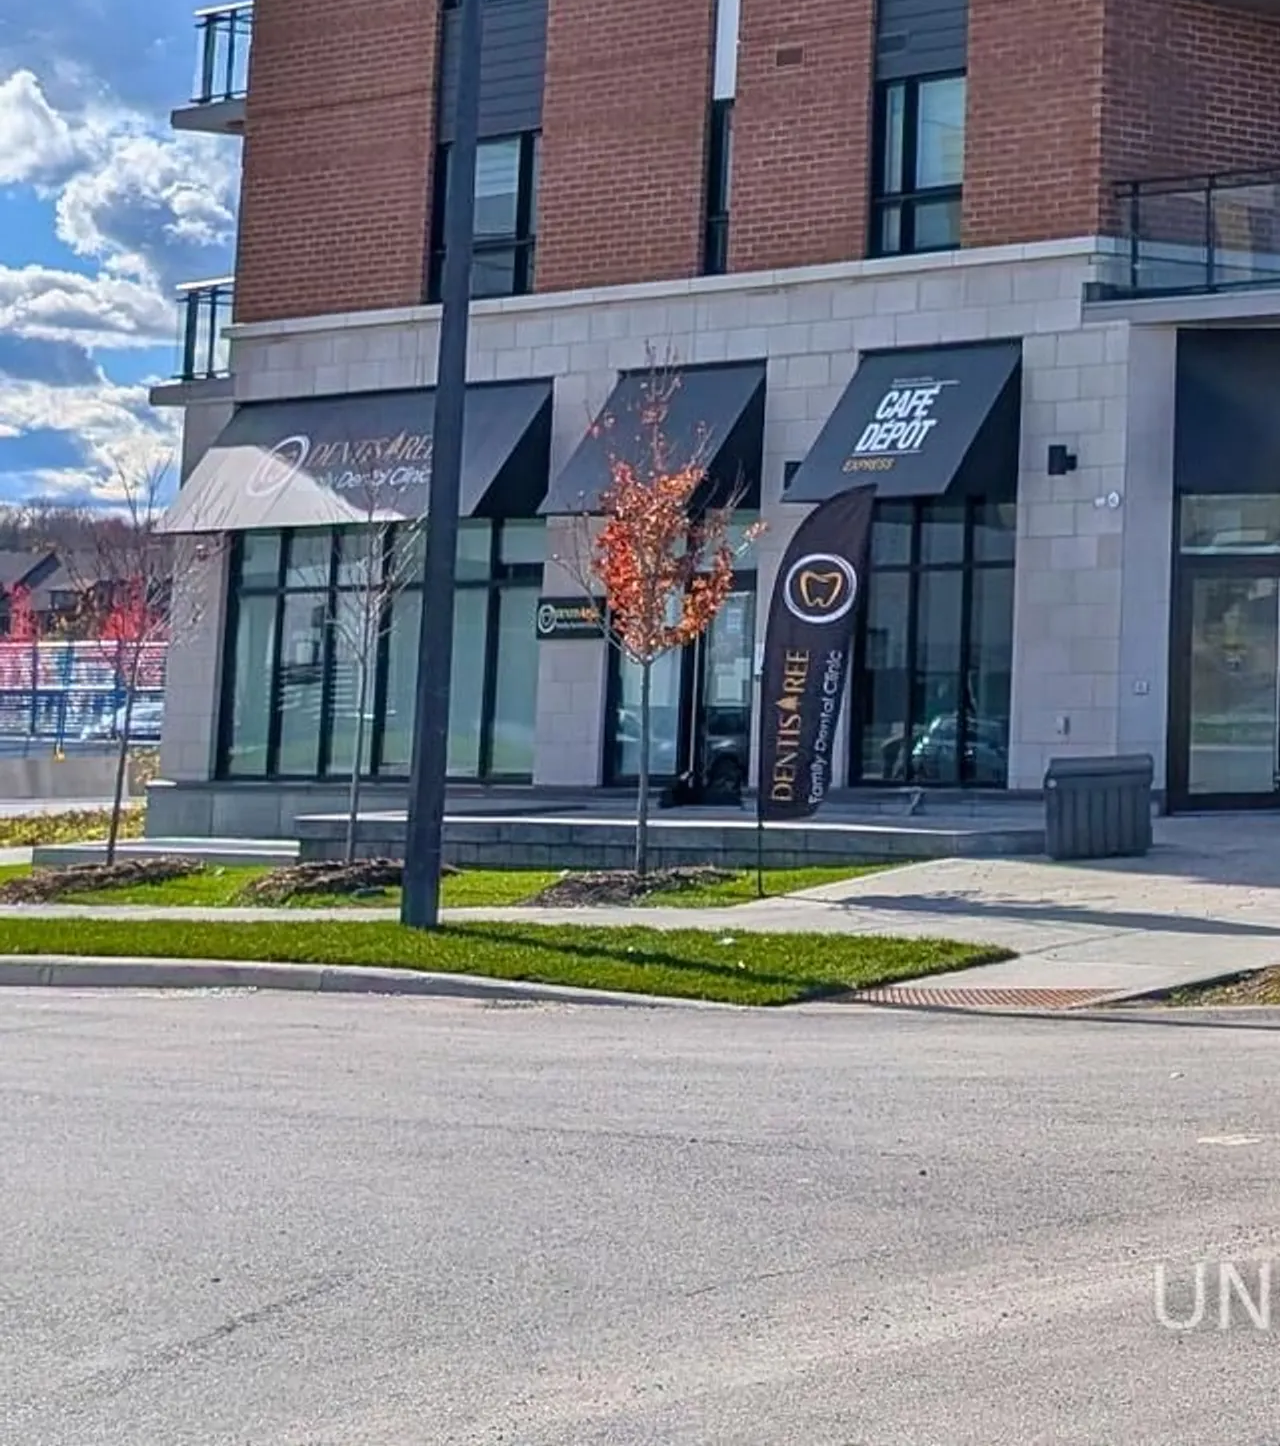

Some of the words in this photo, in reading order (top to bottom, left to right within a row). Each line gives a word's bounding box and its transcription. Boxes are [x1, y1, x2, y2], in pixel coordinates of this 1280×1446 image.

[876, 383, 941, 420] CAFÉ
[823, 650, 843, 695] Clinic
[814, 698, 834, 752] Dental
[808, 755, 828, 804] Family
